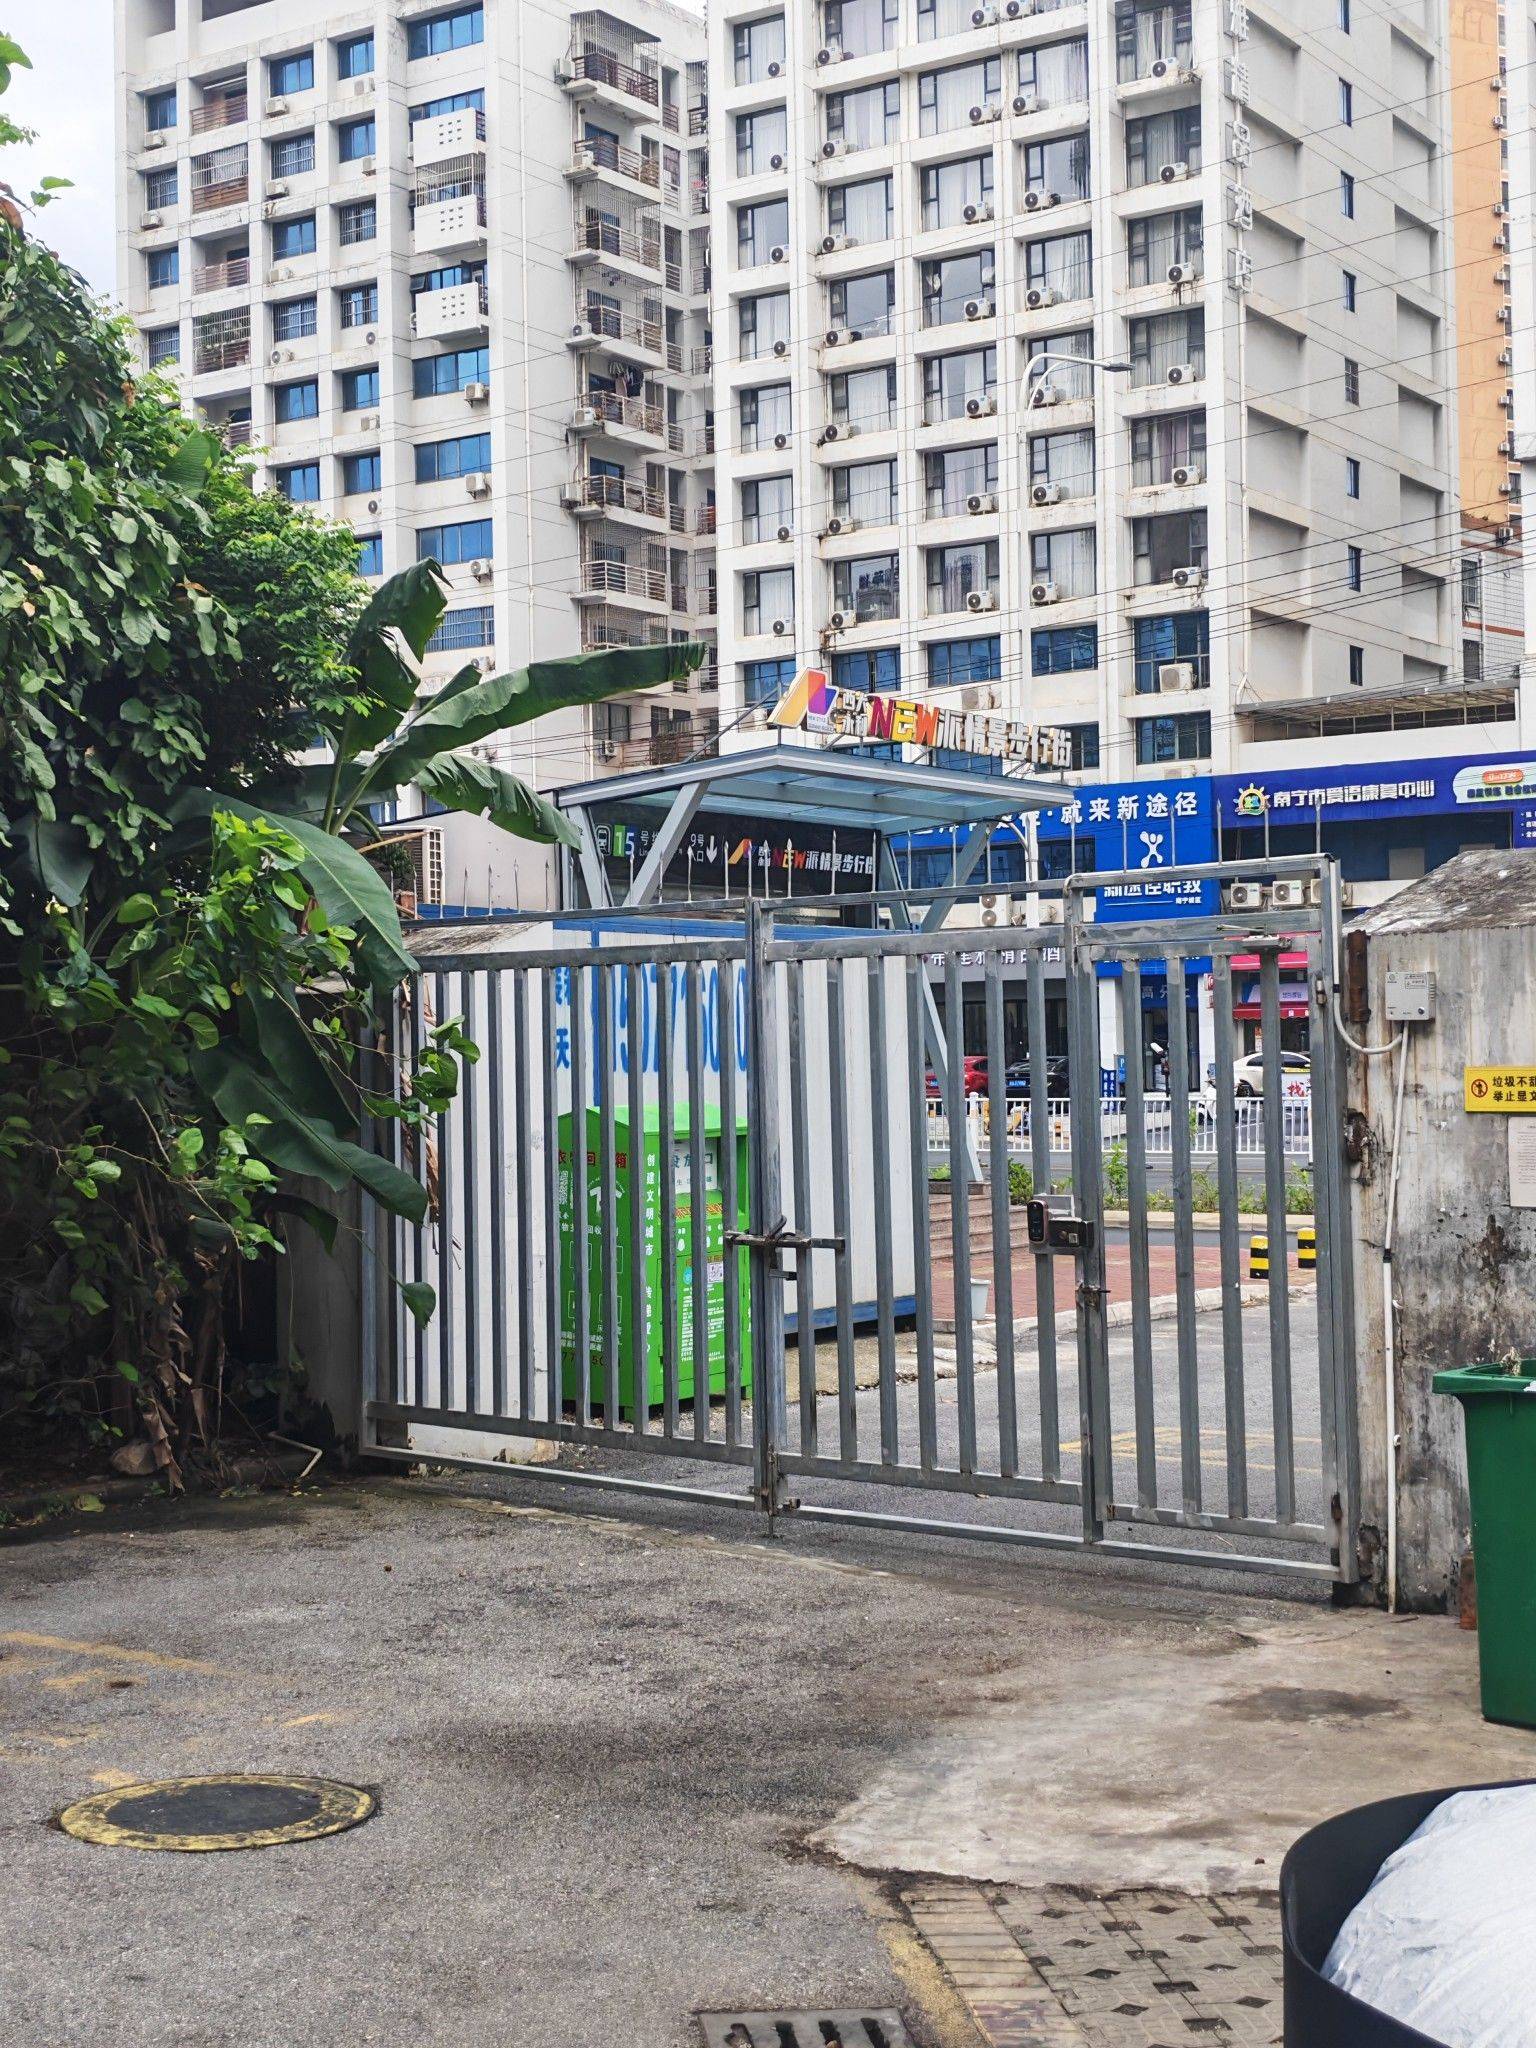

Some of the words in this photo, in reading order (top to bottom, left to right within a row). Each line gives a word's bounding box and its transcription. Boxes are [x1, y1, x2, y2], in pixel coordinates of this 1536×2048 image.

[1273, 780, 1435, 808] 南宁市爱语康复中心
